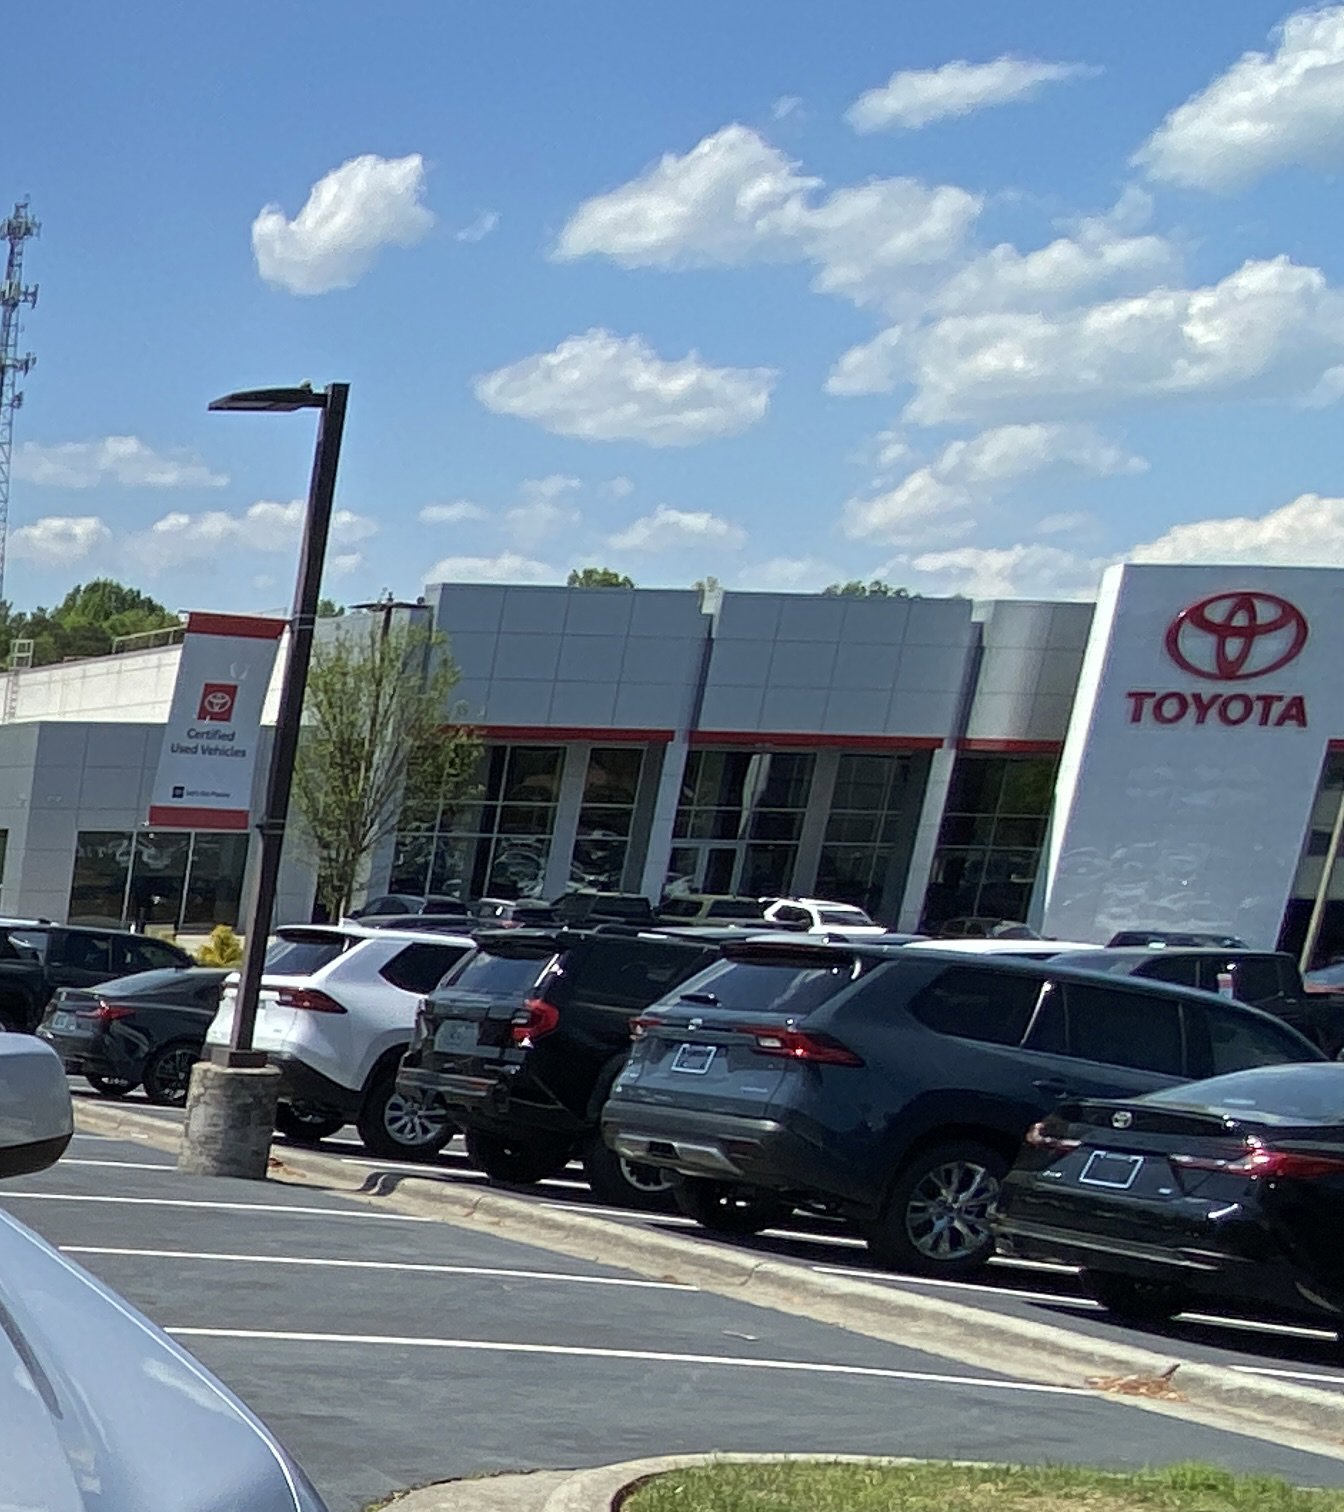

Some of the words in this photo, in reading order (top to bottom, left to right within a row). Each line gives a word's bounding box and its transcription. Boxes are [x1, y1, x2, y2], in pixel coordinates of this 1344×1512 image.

[1127, 691, 1308, 728] TOYOTA
[187, 728, 236, 741] Certified
[170, 743, 199, 755] Used
[201, 744, 246, 757] Vehicles
